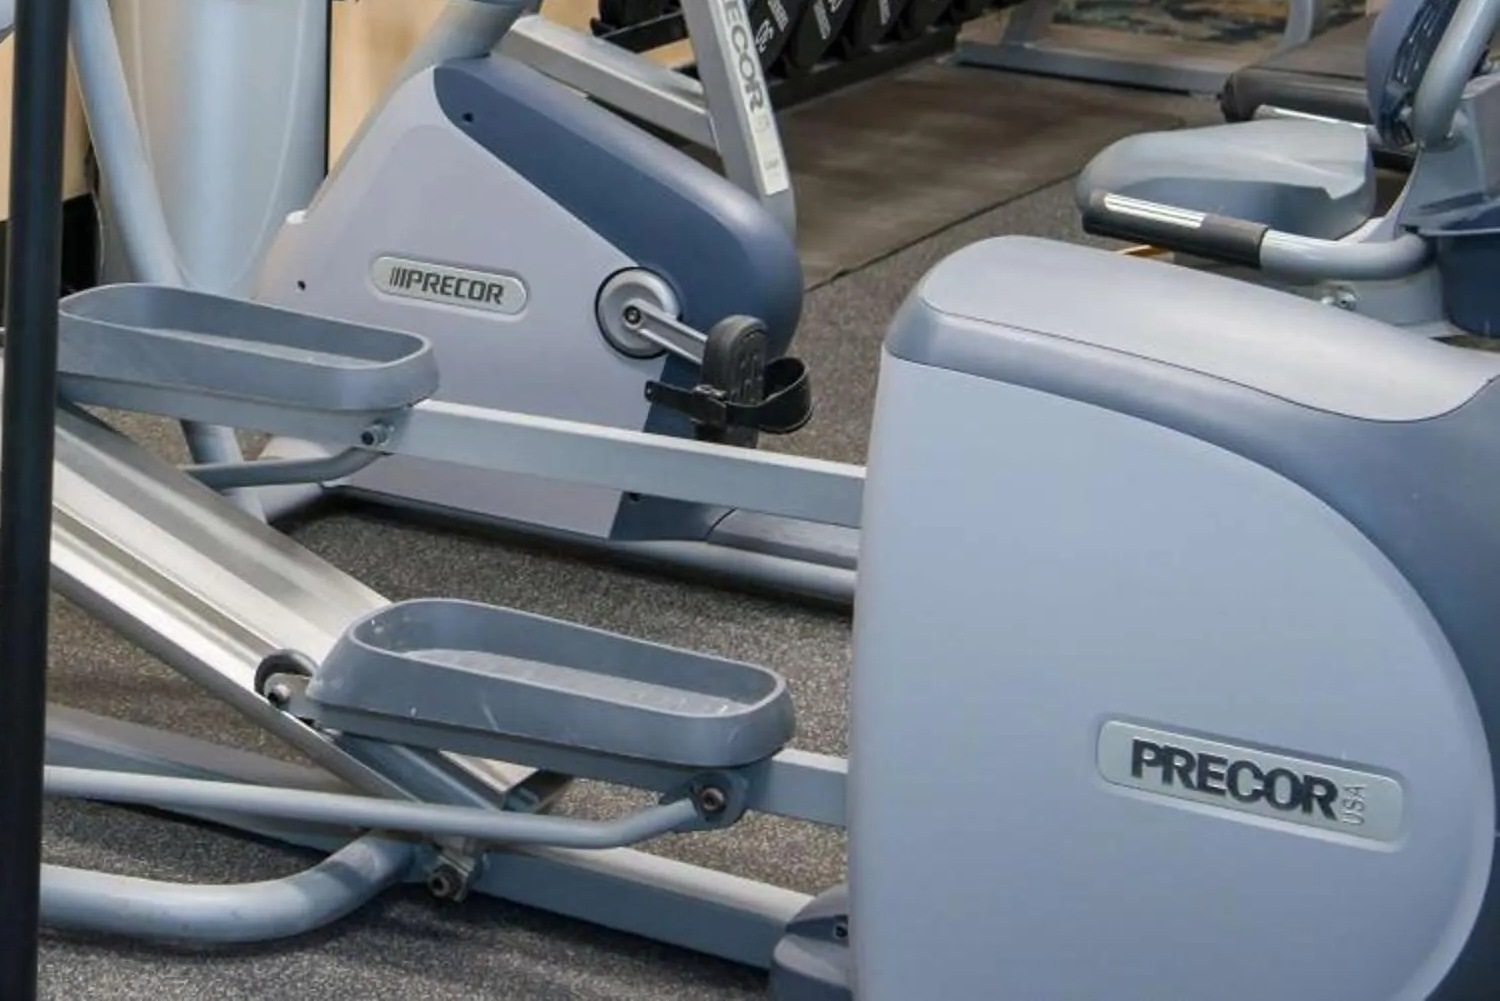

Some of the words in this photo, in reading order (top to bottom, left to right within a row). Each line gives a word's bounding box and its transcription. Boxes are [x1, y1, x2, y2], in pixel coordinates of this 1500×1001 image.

[755, 18, 775, 53] 30
[405, 268, 504, 304] PRECOR
[1132, 739, 1338, 820] PRECOR
[1341, 783, 1366, 827] USA
